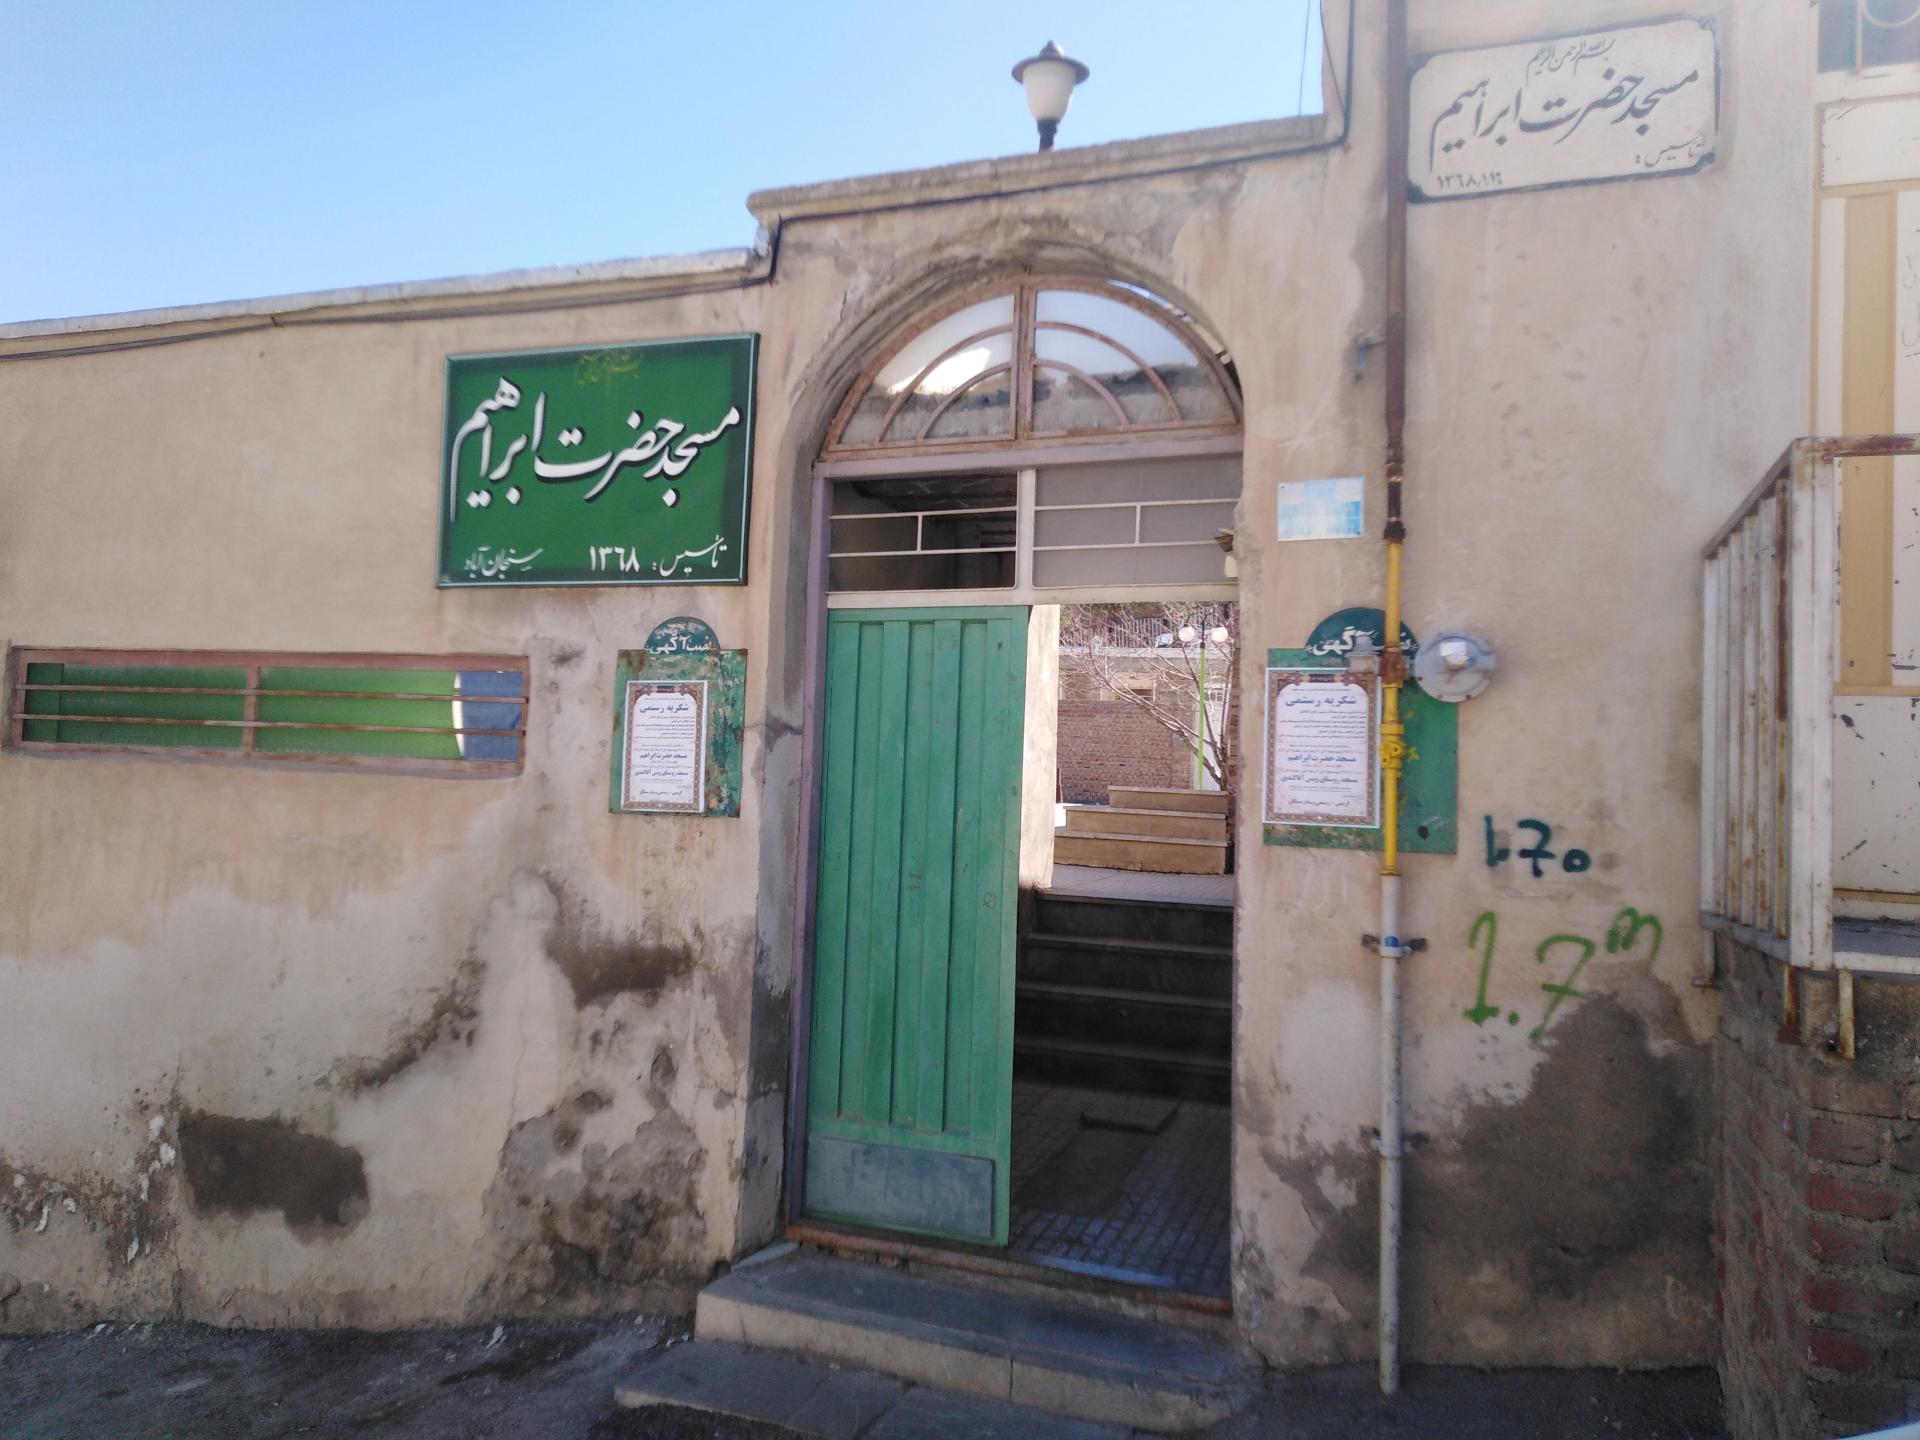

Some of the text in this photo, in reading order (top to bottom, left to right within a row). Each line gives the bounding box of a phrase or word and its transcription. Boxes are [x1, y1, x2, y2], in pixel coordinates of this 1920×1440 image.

[1428, 66, 1699, 173] مسجد حضرت ابراهیم
[449, 376, 741, 523] مسجد حضرت ابراهیم
[588, 545, 641, 573] ۱۳۶۸
